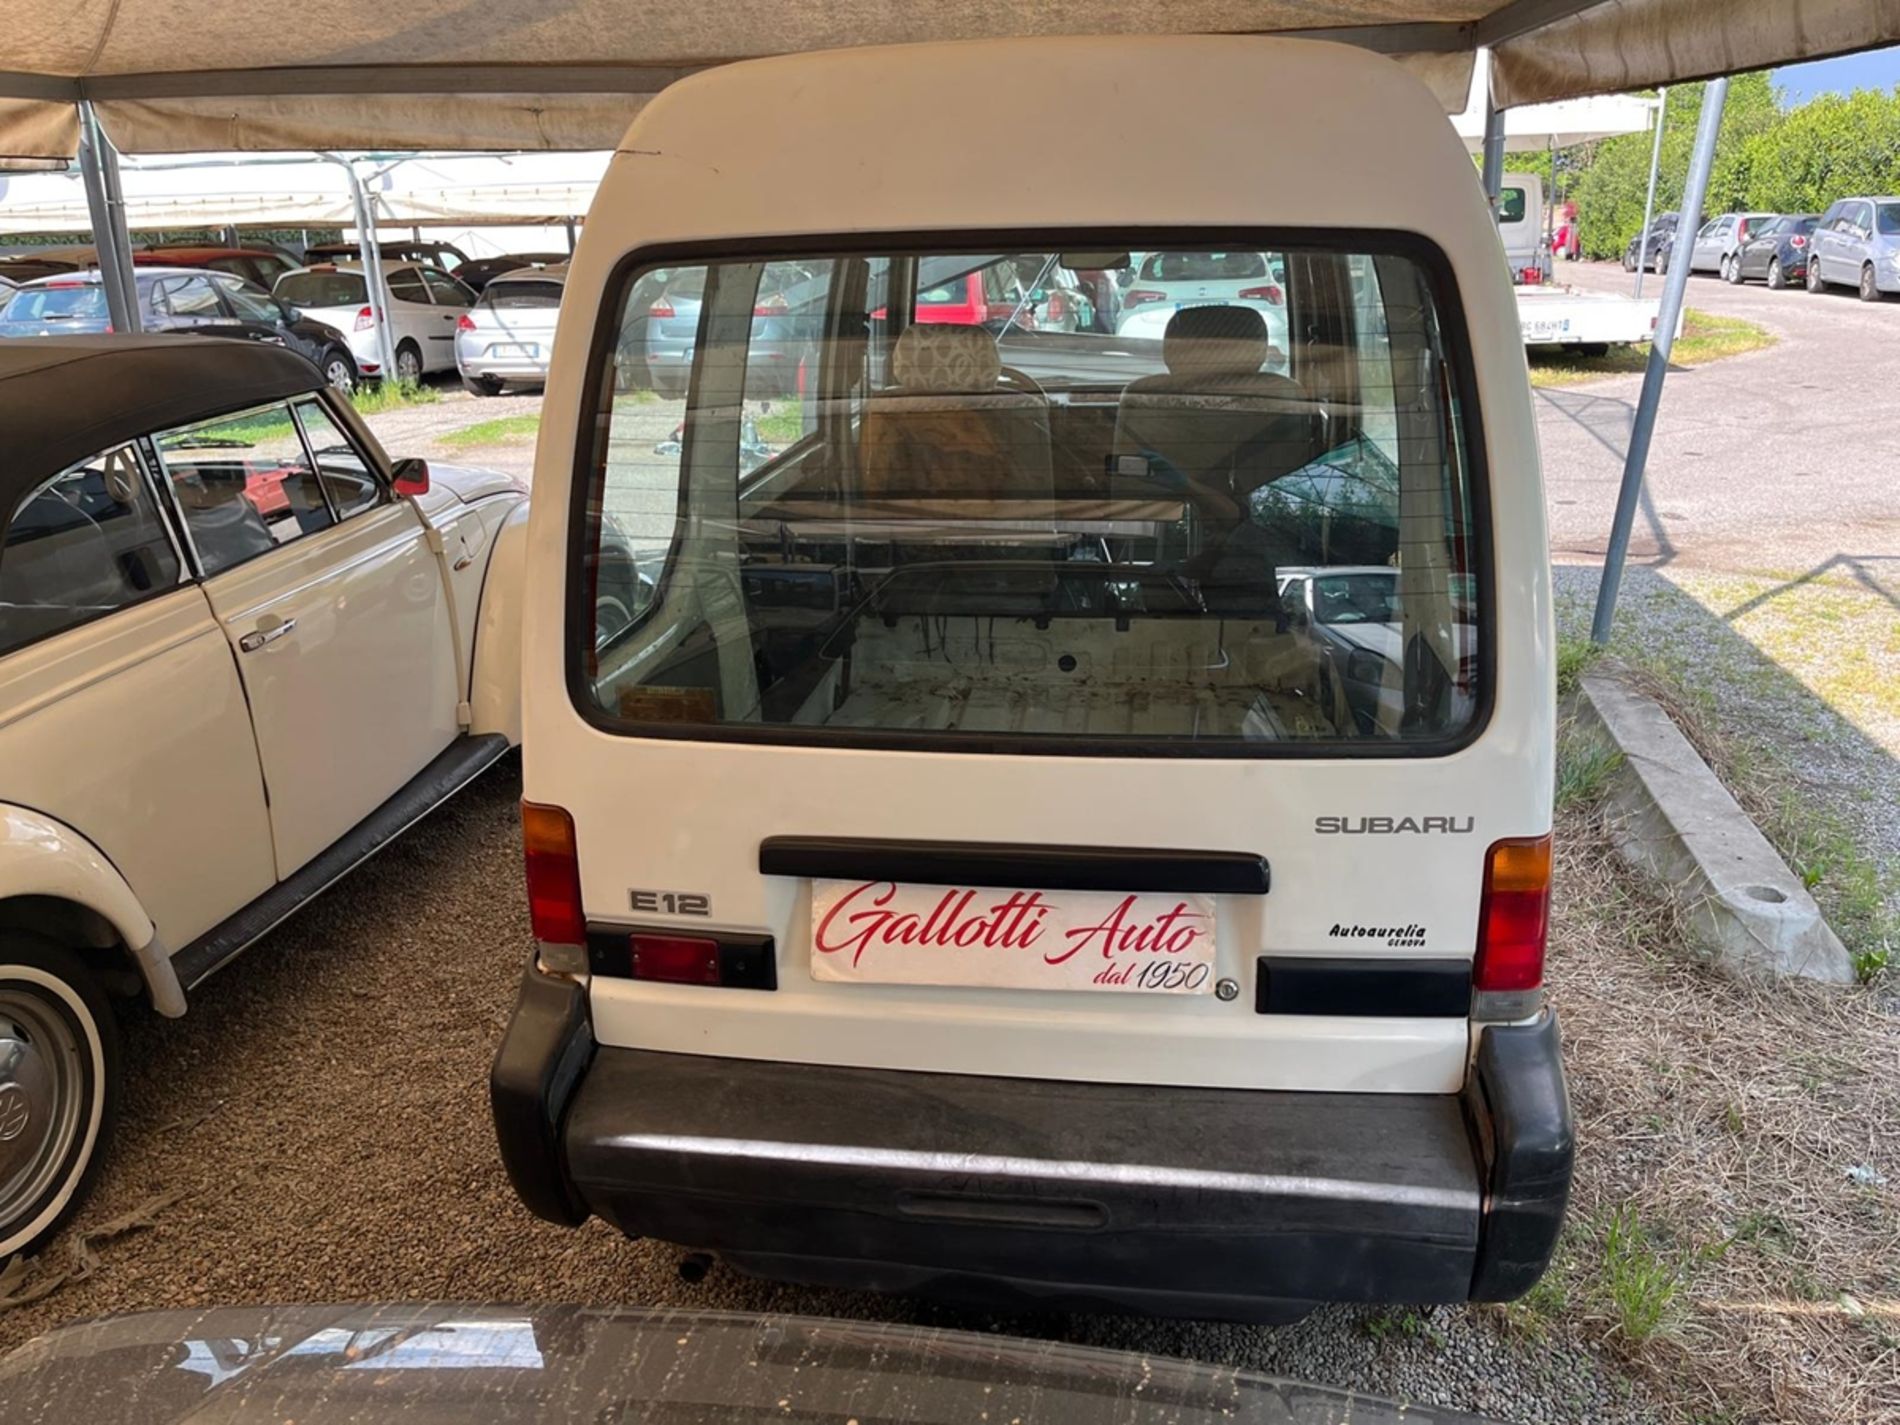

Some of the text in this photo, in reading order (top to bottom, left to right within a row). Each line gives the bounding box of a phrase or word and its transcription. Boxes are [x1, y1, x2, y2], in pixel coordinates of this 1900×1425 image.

[1315, 816, 1475, 834] SUBARU
[630, 891, 709, 916] E12
[815, 880, 1214, 969] Gallotti Auto
[1328, 923, 1427, 938] Autoaurelia
[1387, 938, 1426, 947] GENOVA
[1093, 960, 1210, 990] dal 1950
